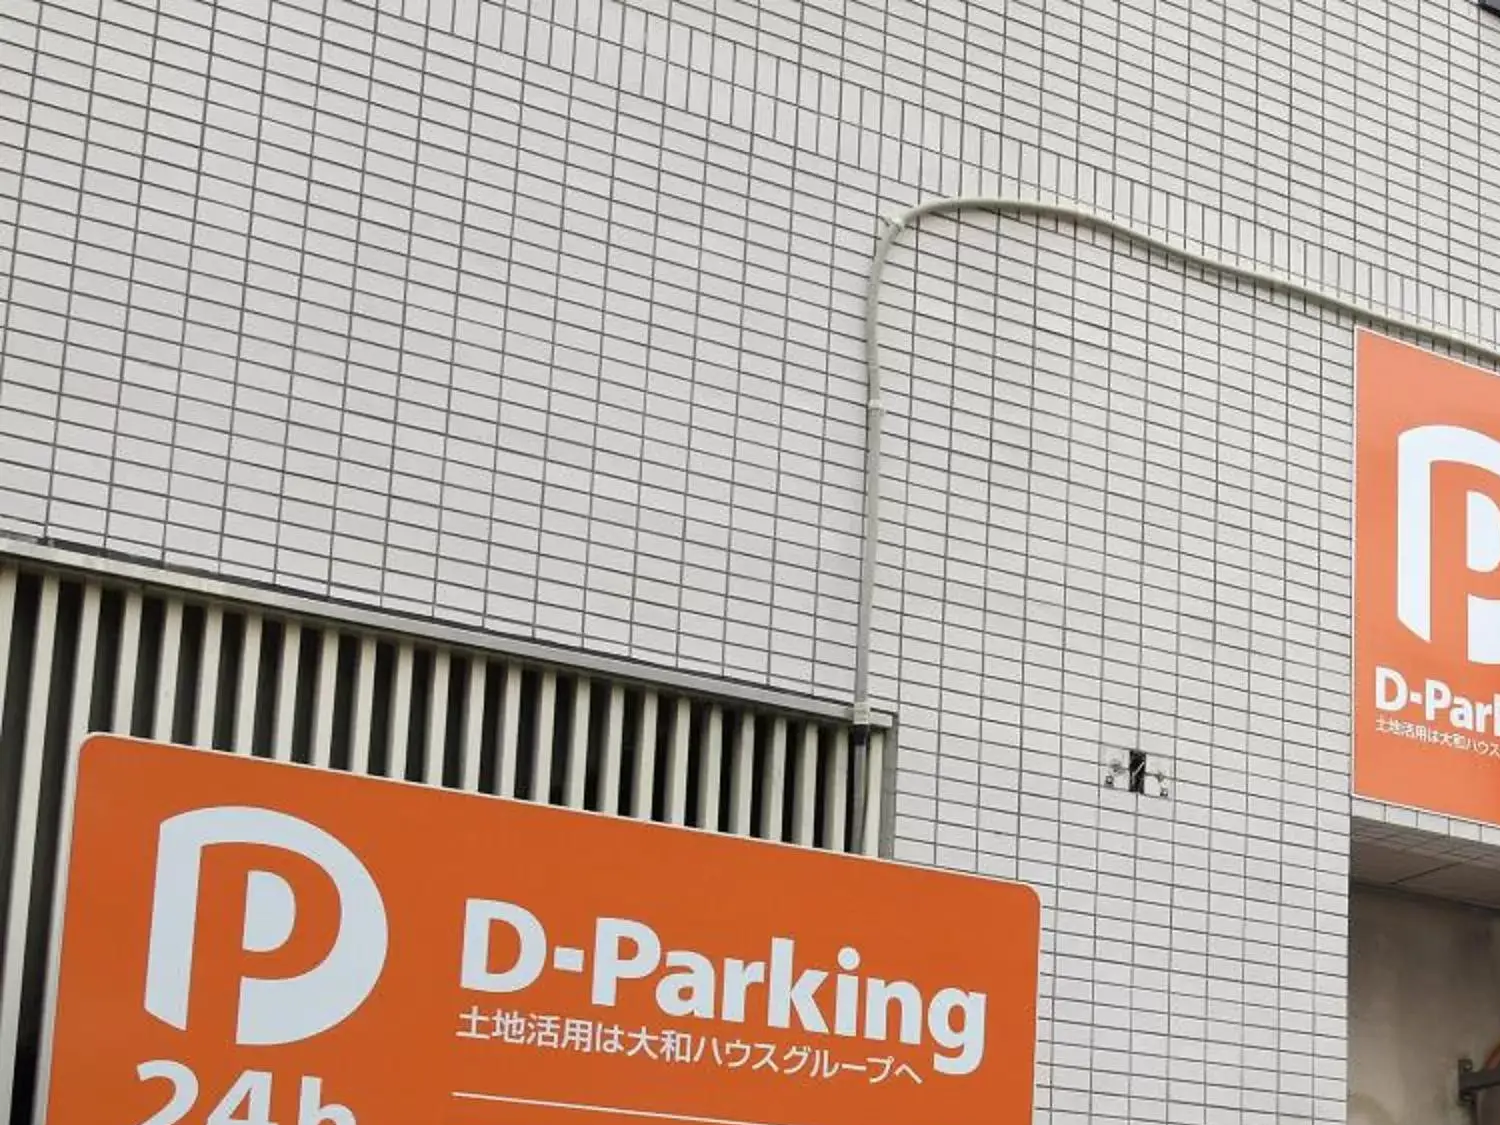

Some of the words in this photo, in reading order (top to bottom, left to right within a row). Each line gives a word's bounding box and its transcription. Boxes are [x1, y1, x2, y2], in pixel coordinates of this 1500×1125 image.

[455, 1009, 922, 1085] 土地活用は大和ハウスグループへ
[458, 898, 986, 1076] D-Parking
